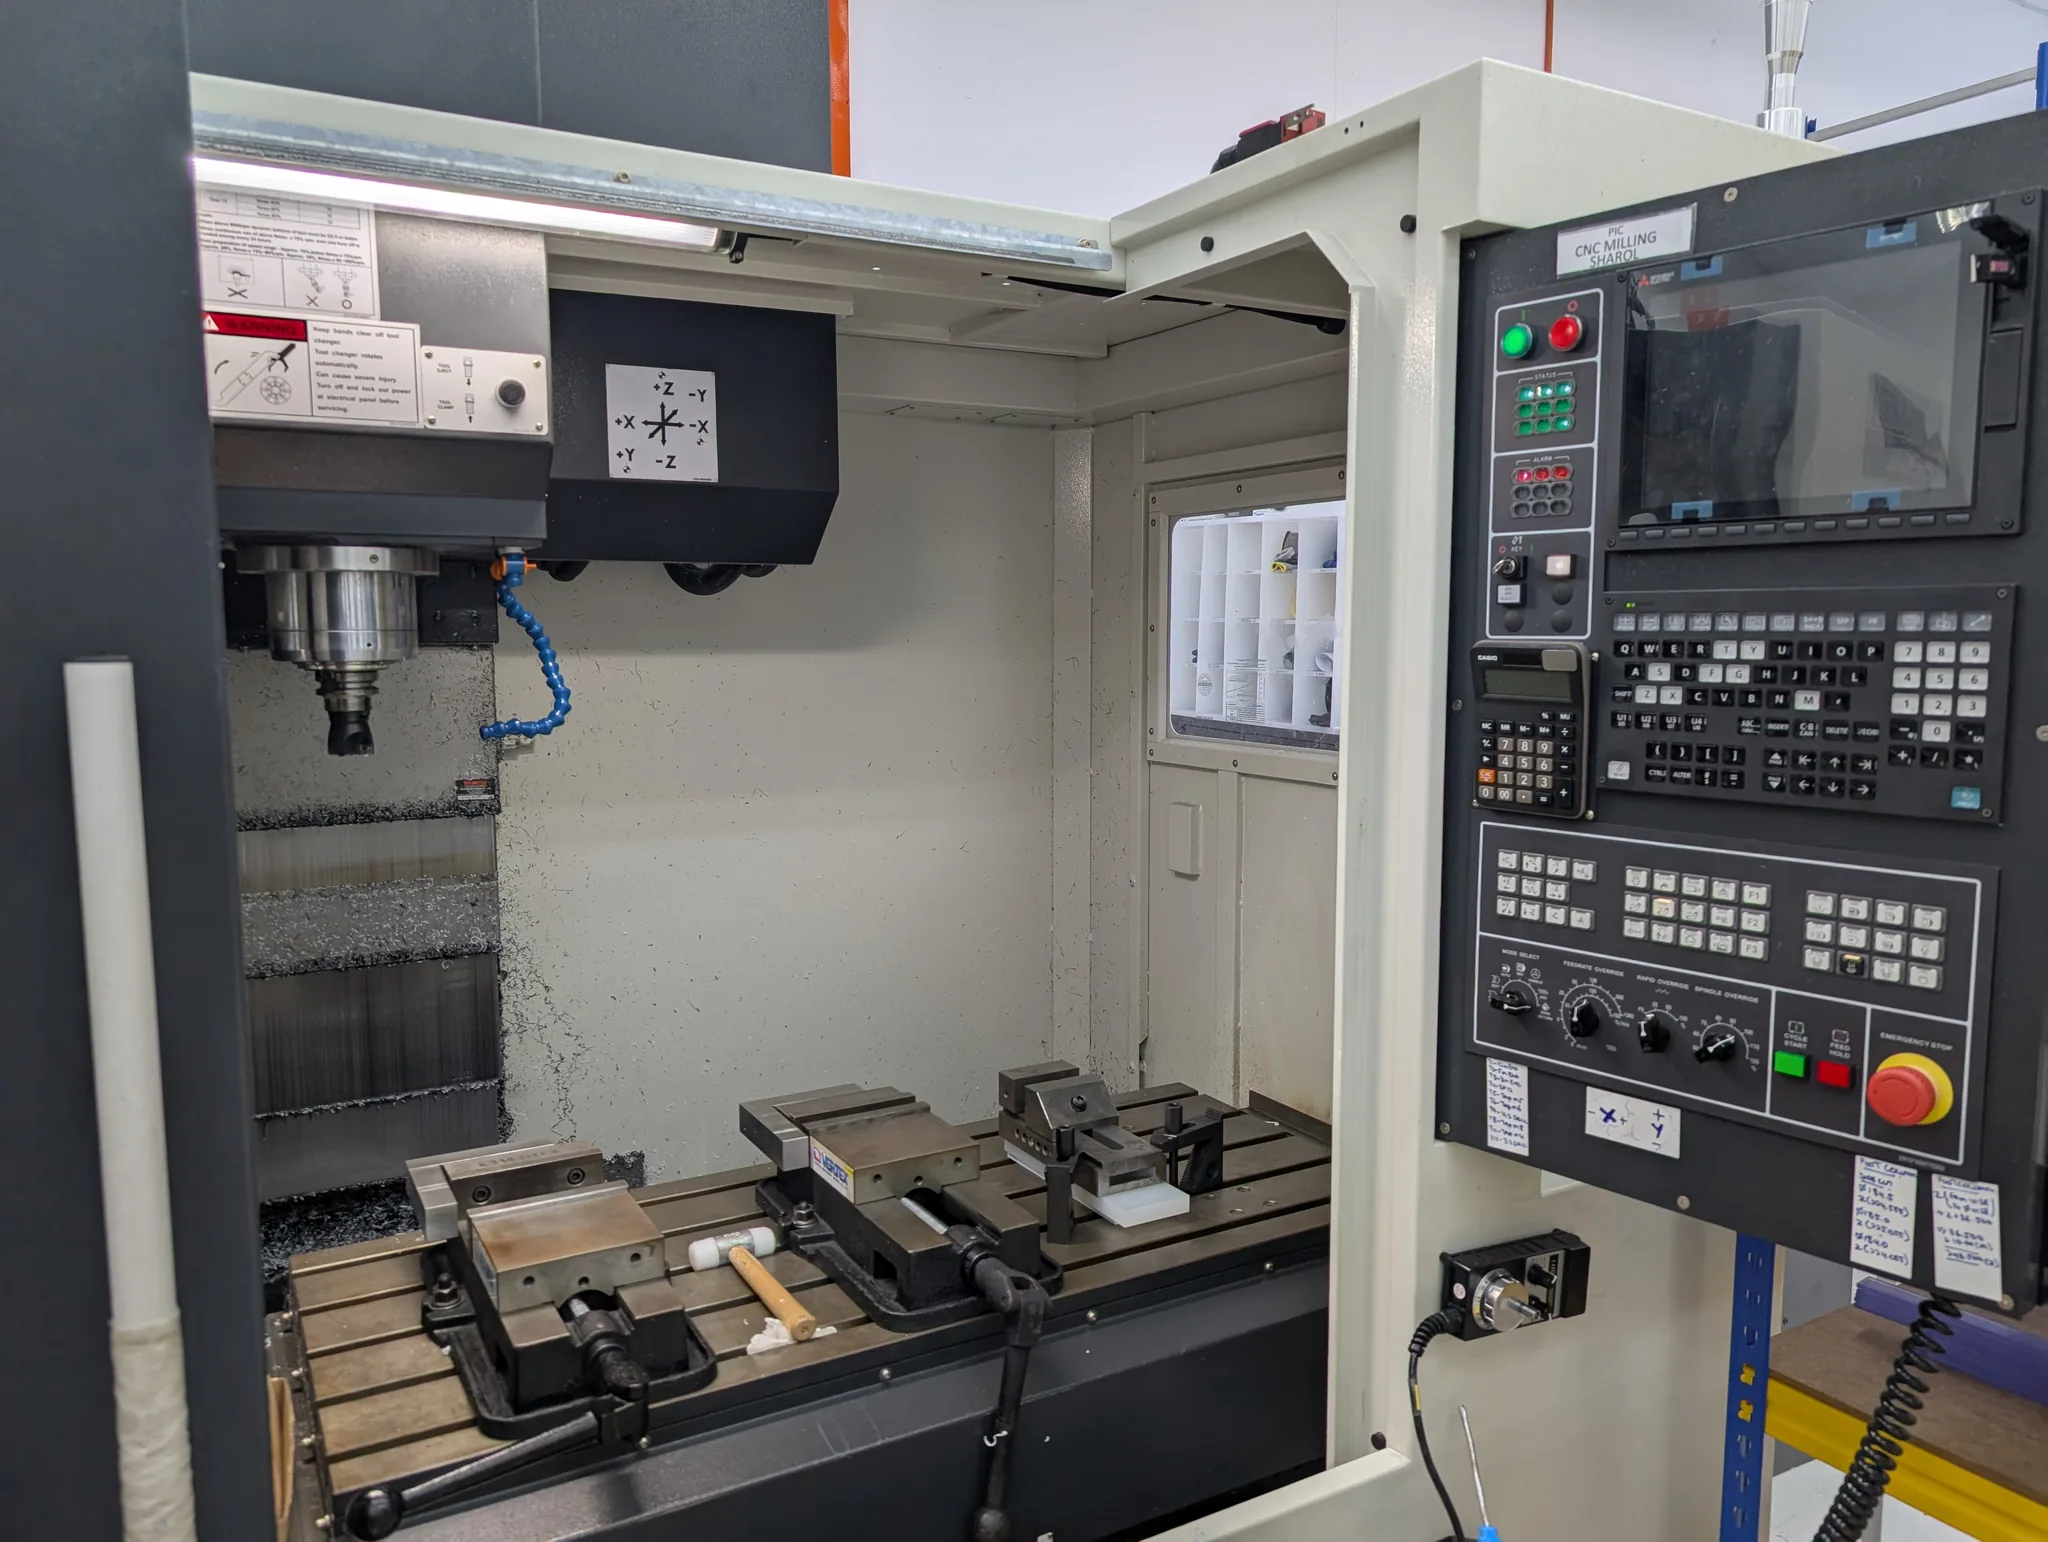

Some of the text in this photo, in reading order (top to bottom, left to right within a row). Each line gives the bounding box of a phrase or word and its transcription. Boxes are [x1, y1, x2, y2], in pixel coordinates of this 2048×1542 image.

[1609, 225, 1624, 237] PIC
[1575, 231, 1657, 258] CNC MILLING
[1590, 248, 1639, 268] SHAROL
[226, 319, 297, 336] WARNING
[313, 326, 330, 334] Keep
[332, 350, 358, 359] changer
[615, 415, 635, 429] +X
[690, 420, 709, 434] -X
[1621, 644, 1630, 654] Q
[1644, 644, 1655, 653] W
[1671, 644, 1678, 653] E
[1697, 645, 1704, 654] R
[1724, 645, 1730, 654] T
[1751, 646, 1757, 654] Y
[1778, 646, 1787, 655] U
[1809, 647, 1813, 656] I
[1836, 646, 1847, 657] O
[1868, 646, 1876, 657] P
[1906, 648, 1913, 656] 7
[1938, 648, 1945, 657] 8
[1972, 648, 1979, 657] 9
[1631, 668, 1640, 676] A
[1658, 668, 1663, 676] S
[1682, 668, 1690, 677] D
[1710, 669, 1715, 677] F
[1736, 670, 1743, 679] G
[1762, 670, 1771, 679] H
[1792, 671, 1798, 681] J
[1820, 672, 1829, 681] K
[1851, 673, 1858, 683] L
[1904, 674, 1911, 682] 4
[1936, 674, 1944, 684] 5
[1971, 675, 1978, 684] 6
[1645, 690, 1651, 698] Z
[1670, 692, 1676, 700] X
[1694, 692, 1702, 701] C
[1720, 693, 1728, 702] V
[1748, 694, 1756, 703] B
[1775, 695, 1784, 704] N
[1804, 696, 1814, 705] M
[1905, 700, 1909, 708] 1
[1936, 700, 1942, 710] 2
[1969, 701, 1977, 711] 3
[1934, 727, 1941, 736] 0
[1502, 740, 1509, 750] 7
[1522, 741, 1529, 751] 8
[1541, 743, 1549, 753] 9
[1502, 756, 1509, 766] 4
[1521, 758, 1528, 768] 5
[1541, 760, 1548, 770] 6
[1503, 773, 1508, 783] 1
[1521, 776, 1528, 786] 2
[1541, 778, 1548, 788] 3
[1483, 788, 1489, 798] 0
[1500, 790, 1510, 800] 00
[1748, 891, 1760, 899] F1
[1748, 918, 1759, 927] F2
[1746, 945, 1758, 954] F3
[1519, 952, 1540, 961] SELECT
[1563, 960, 1625, 977] FEEDRATE OVERRIDE
[1636, 975, 1689, 990] RAPID OVERRIDE
[1694, 986, 1759, 1004] SPINDLE OVERRIDE
[1784, 1032, 1809, 1043] CYCLE
[1880, 1032, 1953, 1052] EMERGENCY STOP
[1784, 1041, 1808, 1050] START
[1830, 1042, 1851, 1052] FEED
[1829, 1050, 1851, 1059] HOLD
[1600, 1107, 1617, 1124] X
[1651, 1123, 1663, 1138] Y
